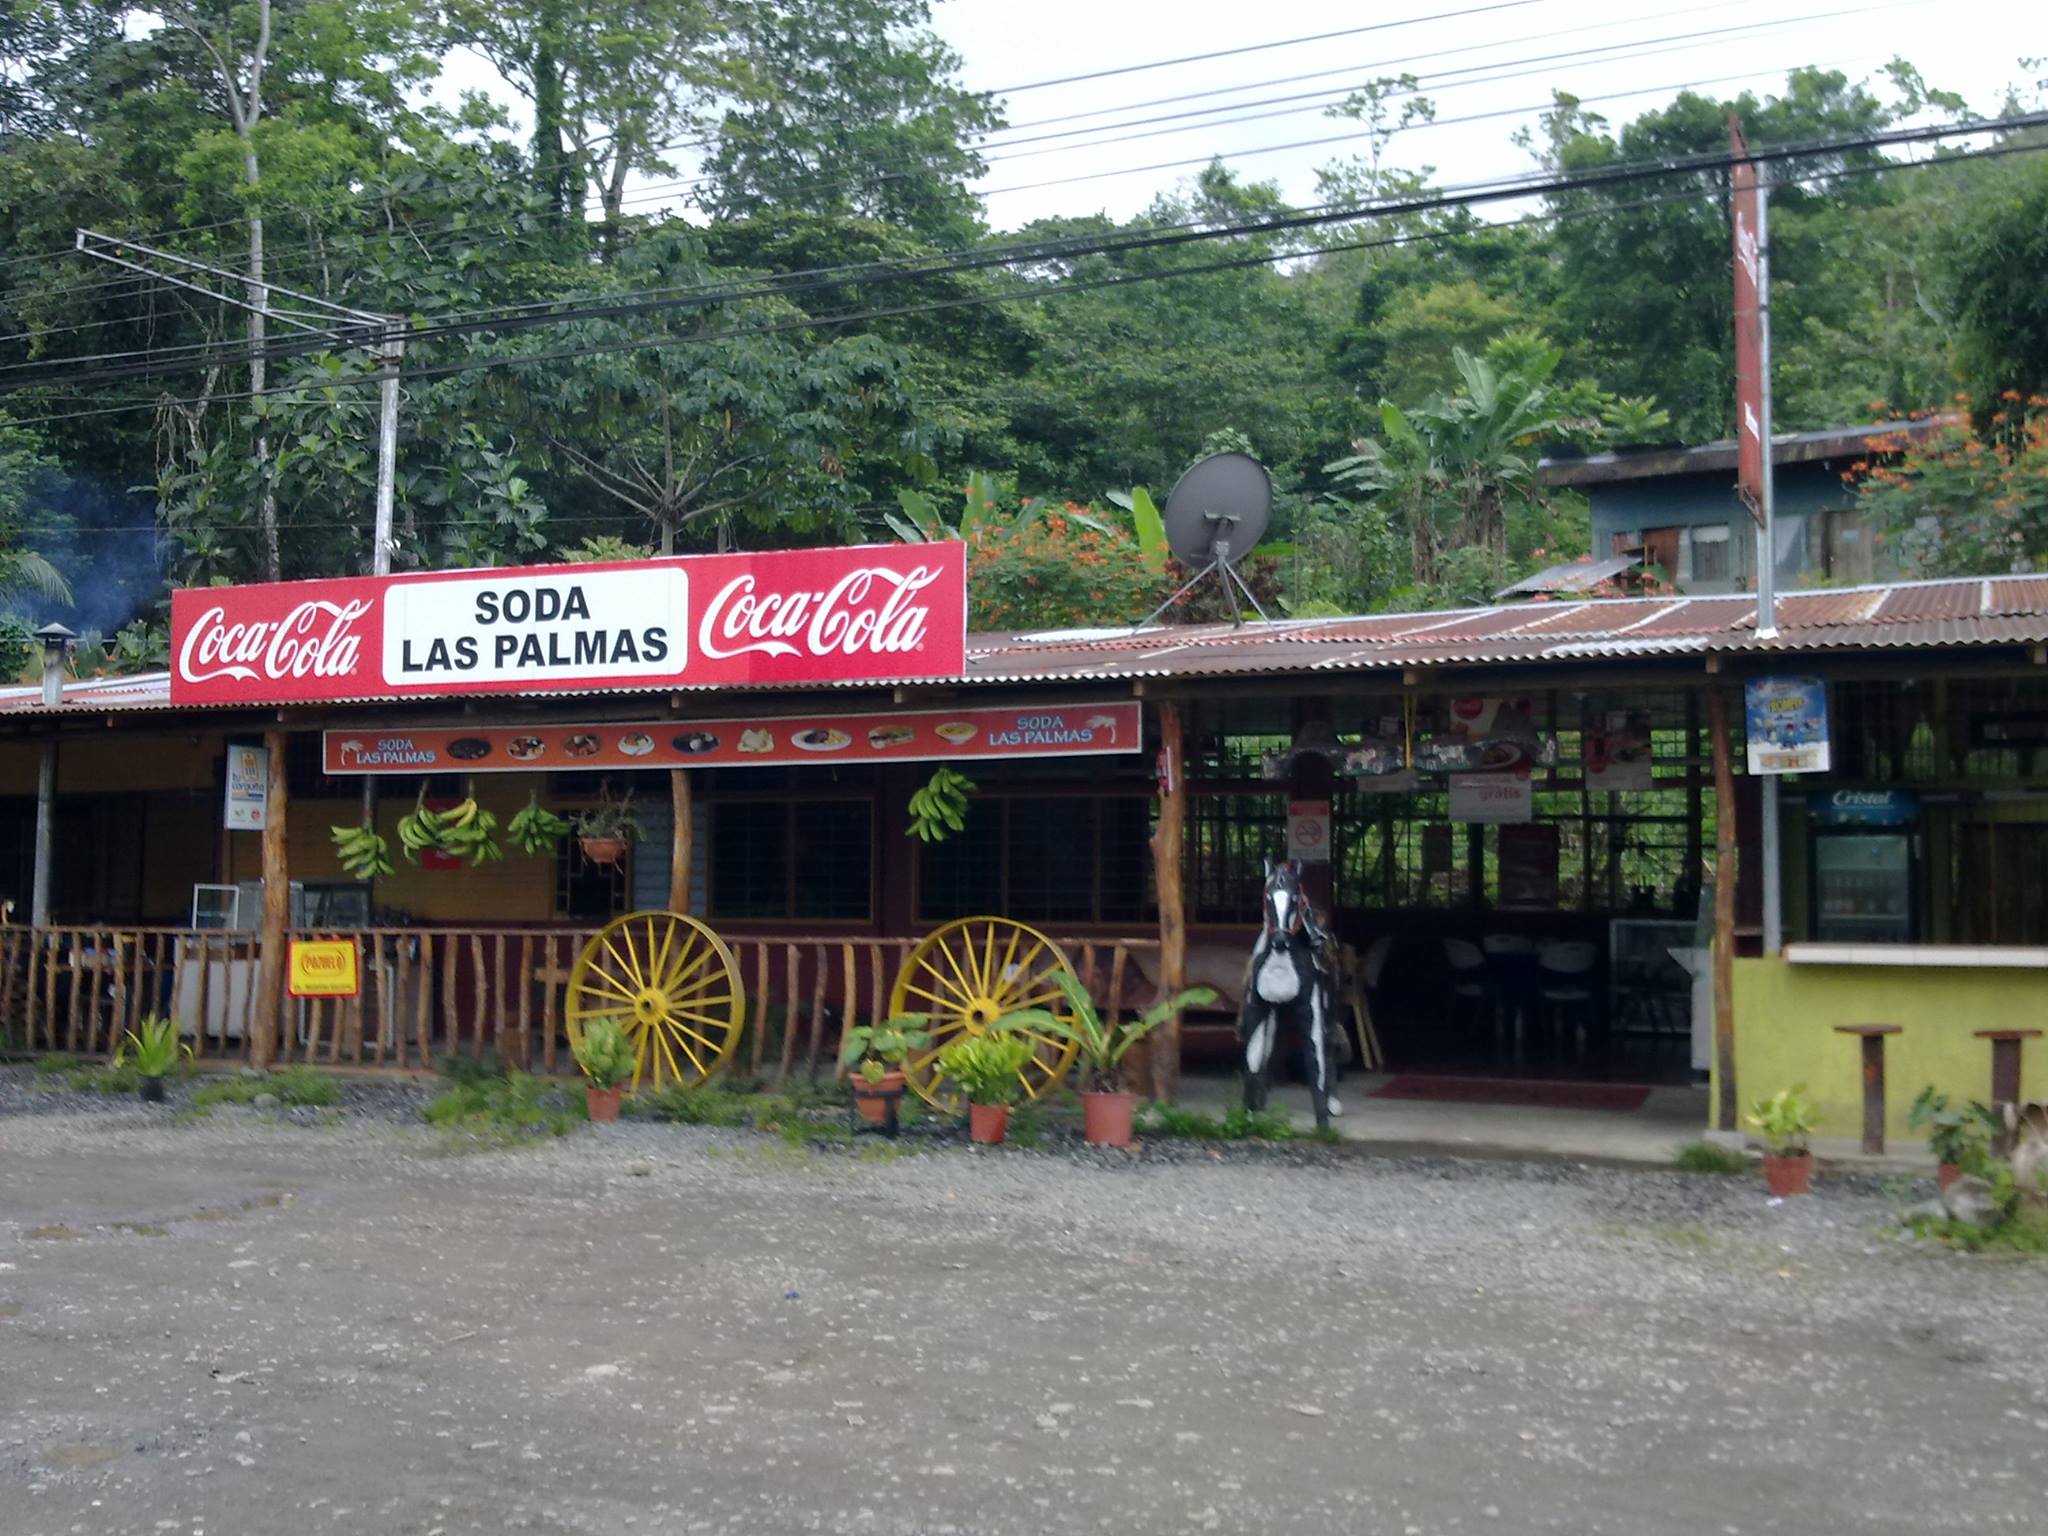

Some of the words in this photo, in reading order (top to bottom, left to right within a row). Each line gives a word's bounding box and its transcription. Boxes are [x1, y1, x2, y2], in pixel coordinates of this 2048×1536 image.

[475, 586, 591, 625] SODA
[699, 565, 945, 659] Coca-Cola
[179, 598, 374, 684] Coca-Cola
[402, 636, 478, 672] LAS
[494, 627, 669, 669] PALMAS
[1017, 715, 1064, 730] SODA
[377, 738, 415, 752] SODA
[989, 730, 1021, 746] LAS
[1024, 728, 1093, 744] PALMAS
[356, 751, 380, 764] LAS
[383, 750, 436, 764] PALMAS
